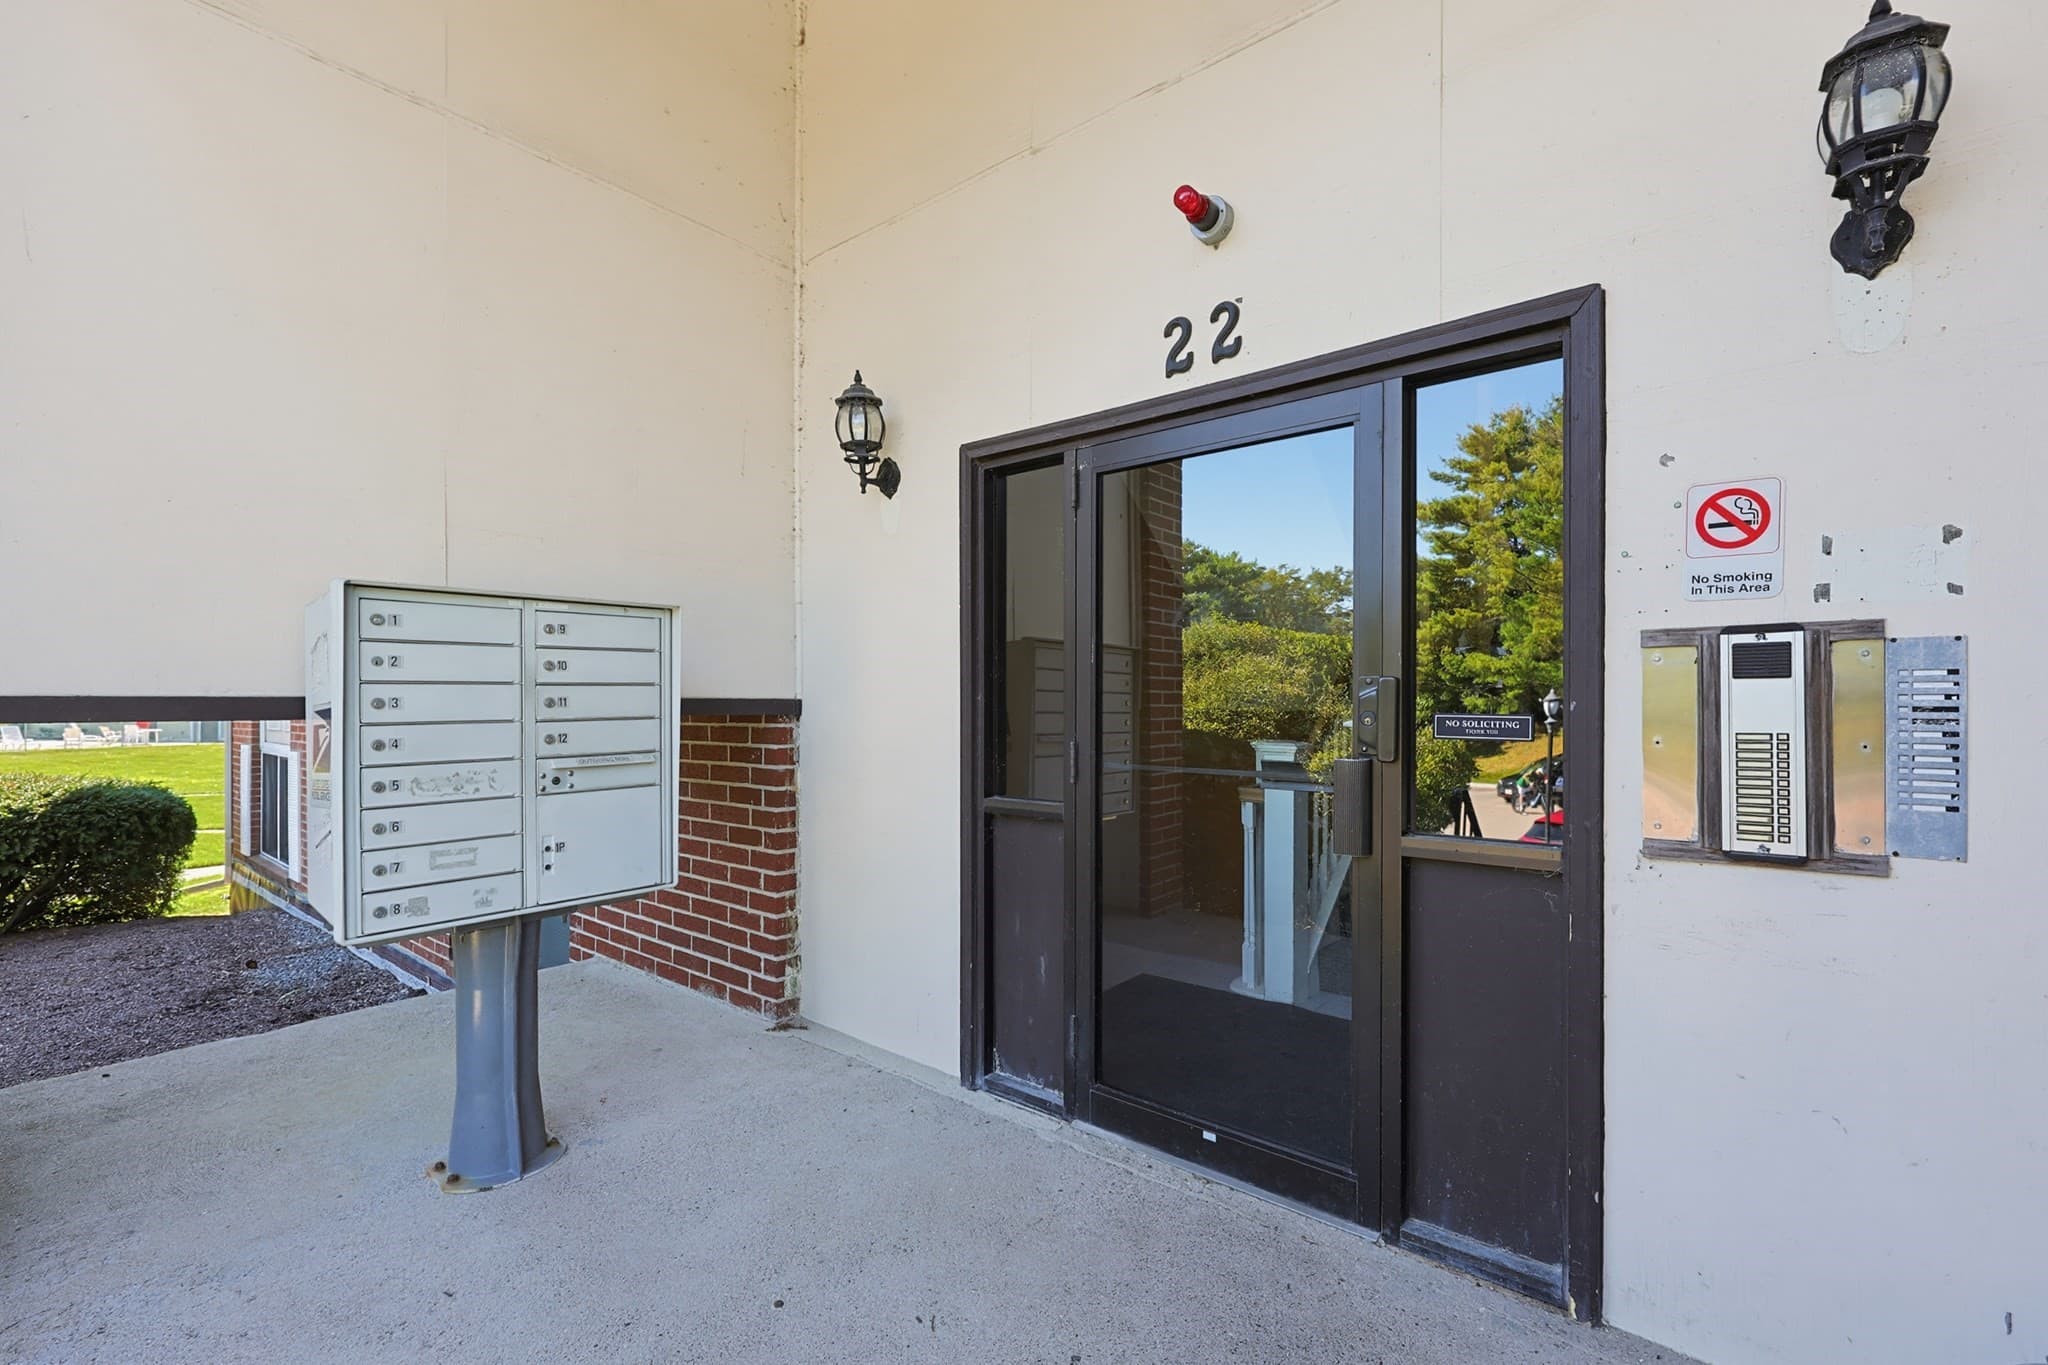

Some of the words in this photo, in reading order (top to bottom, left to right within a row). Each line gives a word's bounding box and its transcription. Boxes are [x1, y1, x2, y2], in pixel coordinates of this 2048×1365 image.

[1163, 300, 1243, 379] 22
[1691, 574, 1710, 584] No
[1713, 571, 1773, 583] Smoking
[1691, 586, 1703, 596] In
[1706, 584, 1735, 595] This
[1738, 583, 1771, 593] Area
[392, 615, 398, 627] 1
[559, 624, 566, 635] 9
[391, 655, 399, 668] 2
[557, 660, 568, 672] 10
[391, 697, 400, 709] 3
[557, 697, 568, 708] 11
[1445, 719, 1460, 728] NO
[1462, 720, 1520, 729] SOLICITING
[391, 738, 399, 750] 4
[557, 733, 568, 744] 12
[392, 779, 400, 792] 5
[392, 821, 400, 833] 6
[393, 862, 401, 873] 7
[393, 903, 401, 915] 8
